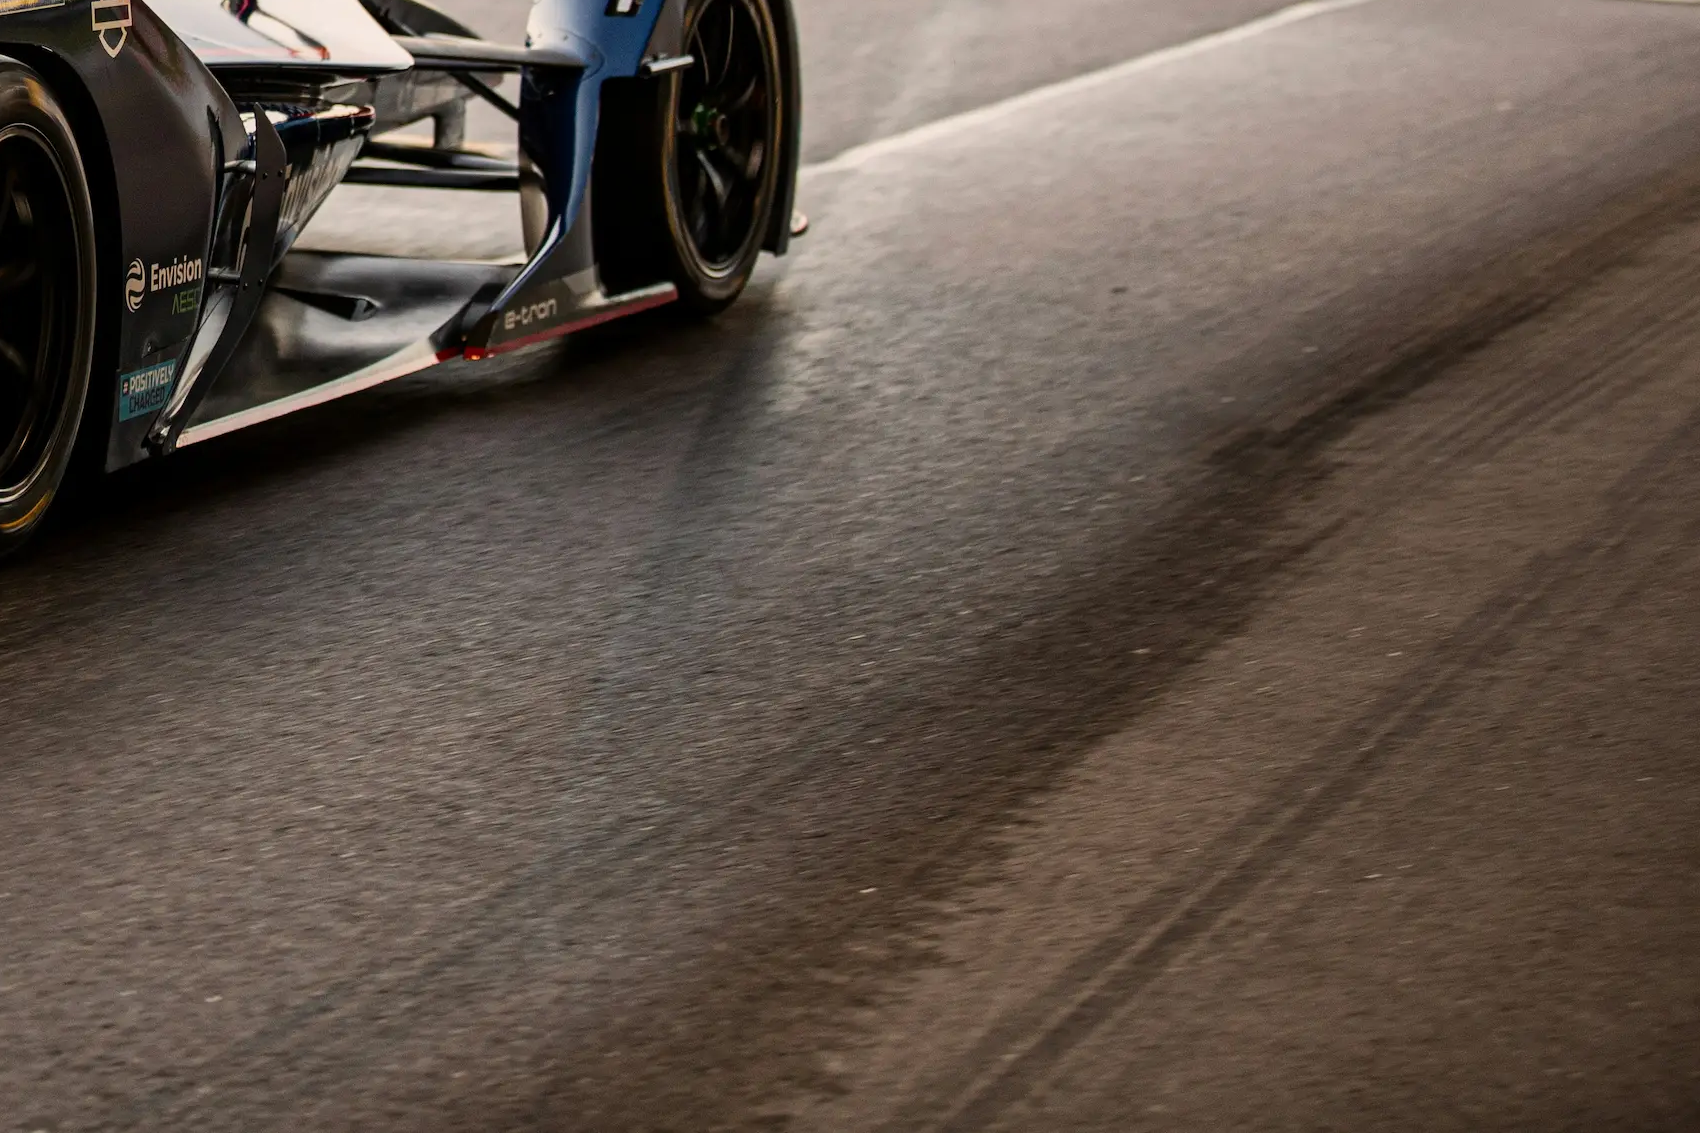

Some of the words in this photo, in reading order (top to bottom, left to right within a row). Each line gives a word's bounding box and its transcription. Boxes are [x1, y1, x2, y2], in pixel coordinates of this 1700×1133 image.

[150, 254, 202, 292] Envision
[504, 297, 557, 330] e-tron
[129, 386, 166, 414] CHARGED
